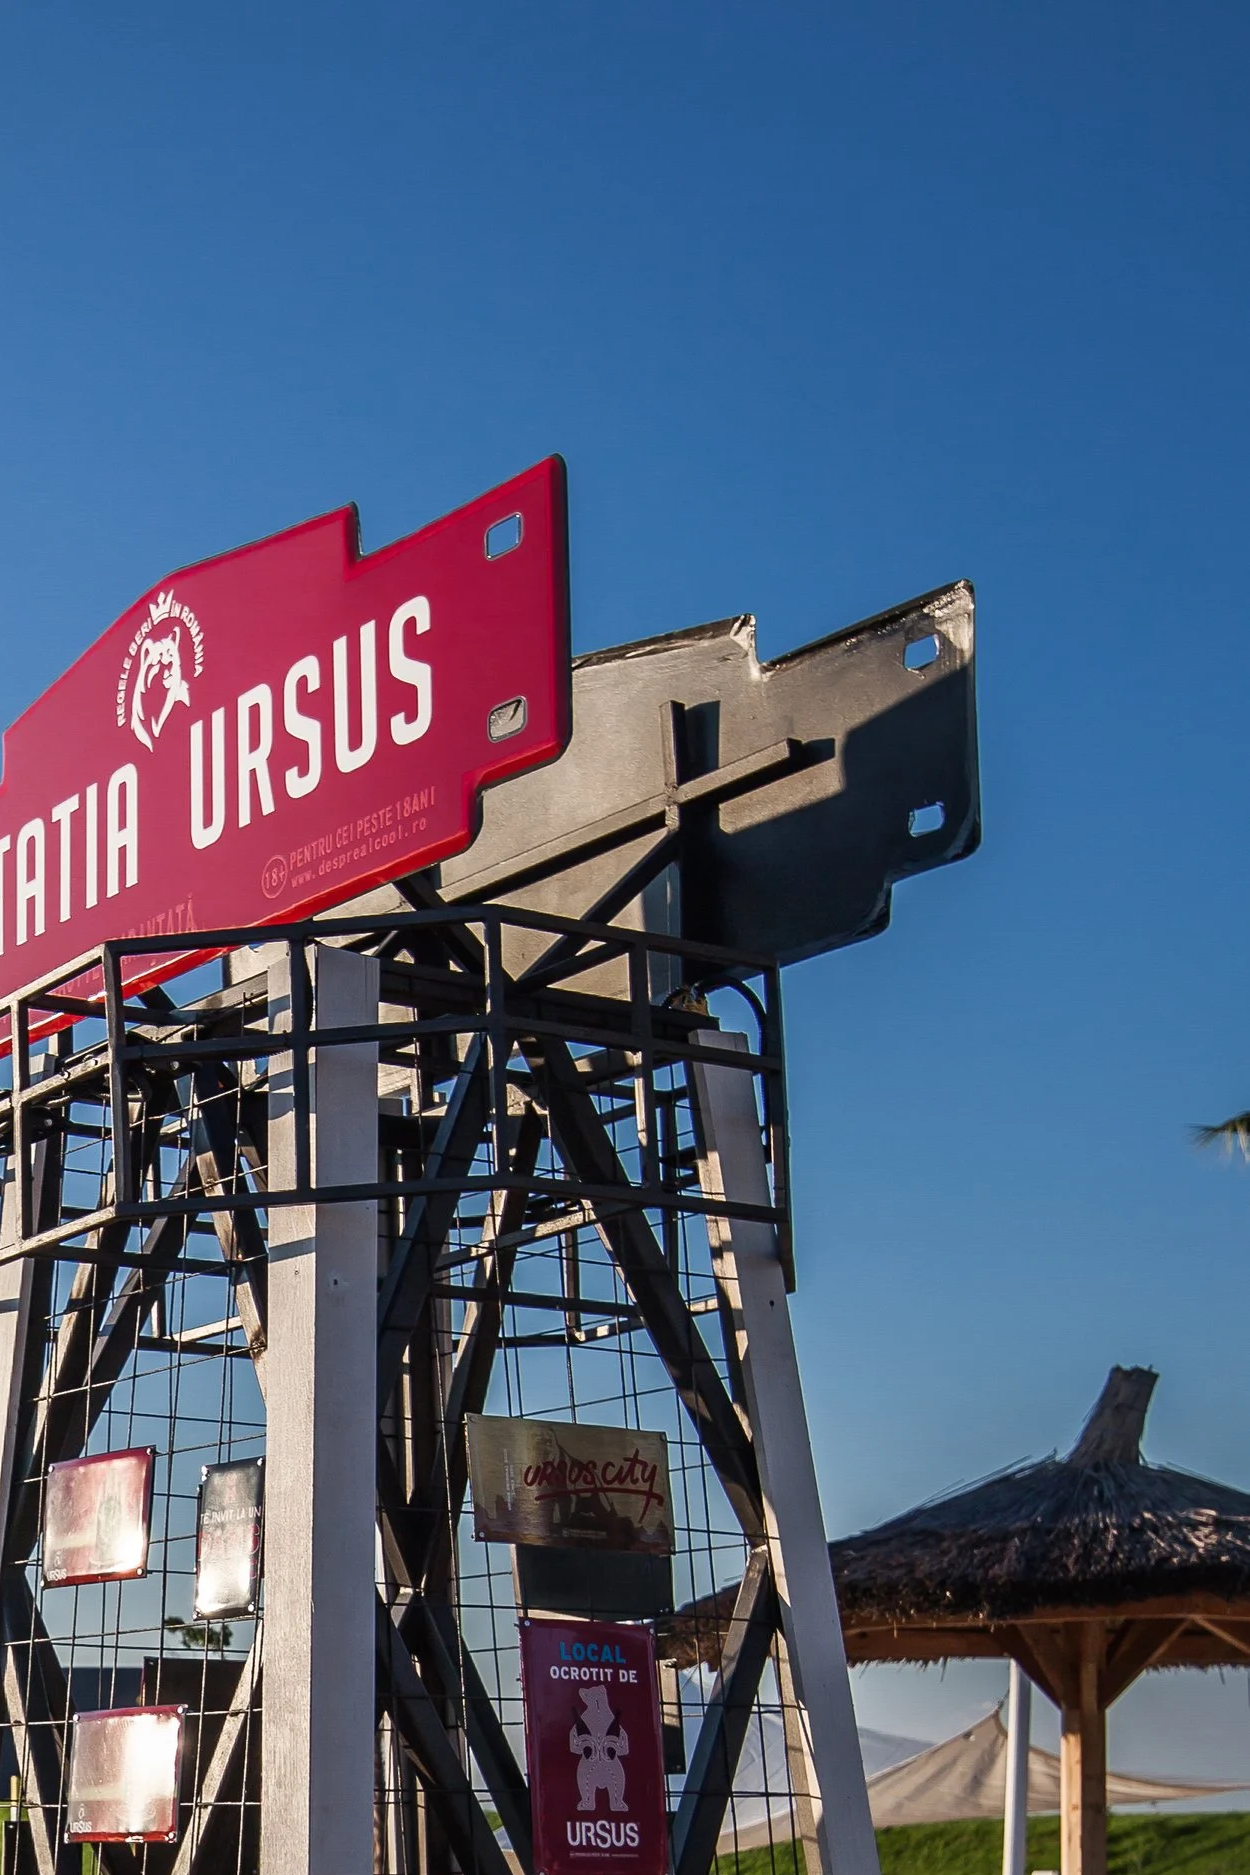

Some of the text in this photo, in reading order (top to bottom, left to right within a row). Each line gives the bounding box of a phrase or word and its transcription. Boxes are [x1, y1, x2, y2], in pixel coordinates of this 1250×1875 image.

[189, 595, 433, 850] URSUS
[289, 834, 333, 871] PENTRU
[335, 822, 354, 848] CEI
[356, 805, 393, 839] PESTE
[559, 1641, 627, 1664] LOCAL
[549, 1665, 638, 1684] OCROTIT DE
[566, 1820, 640, 1848] URSUS
